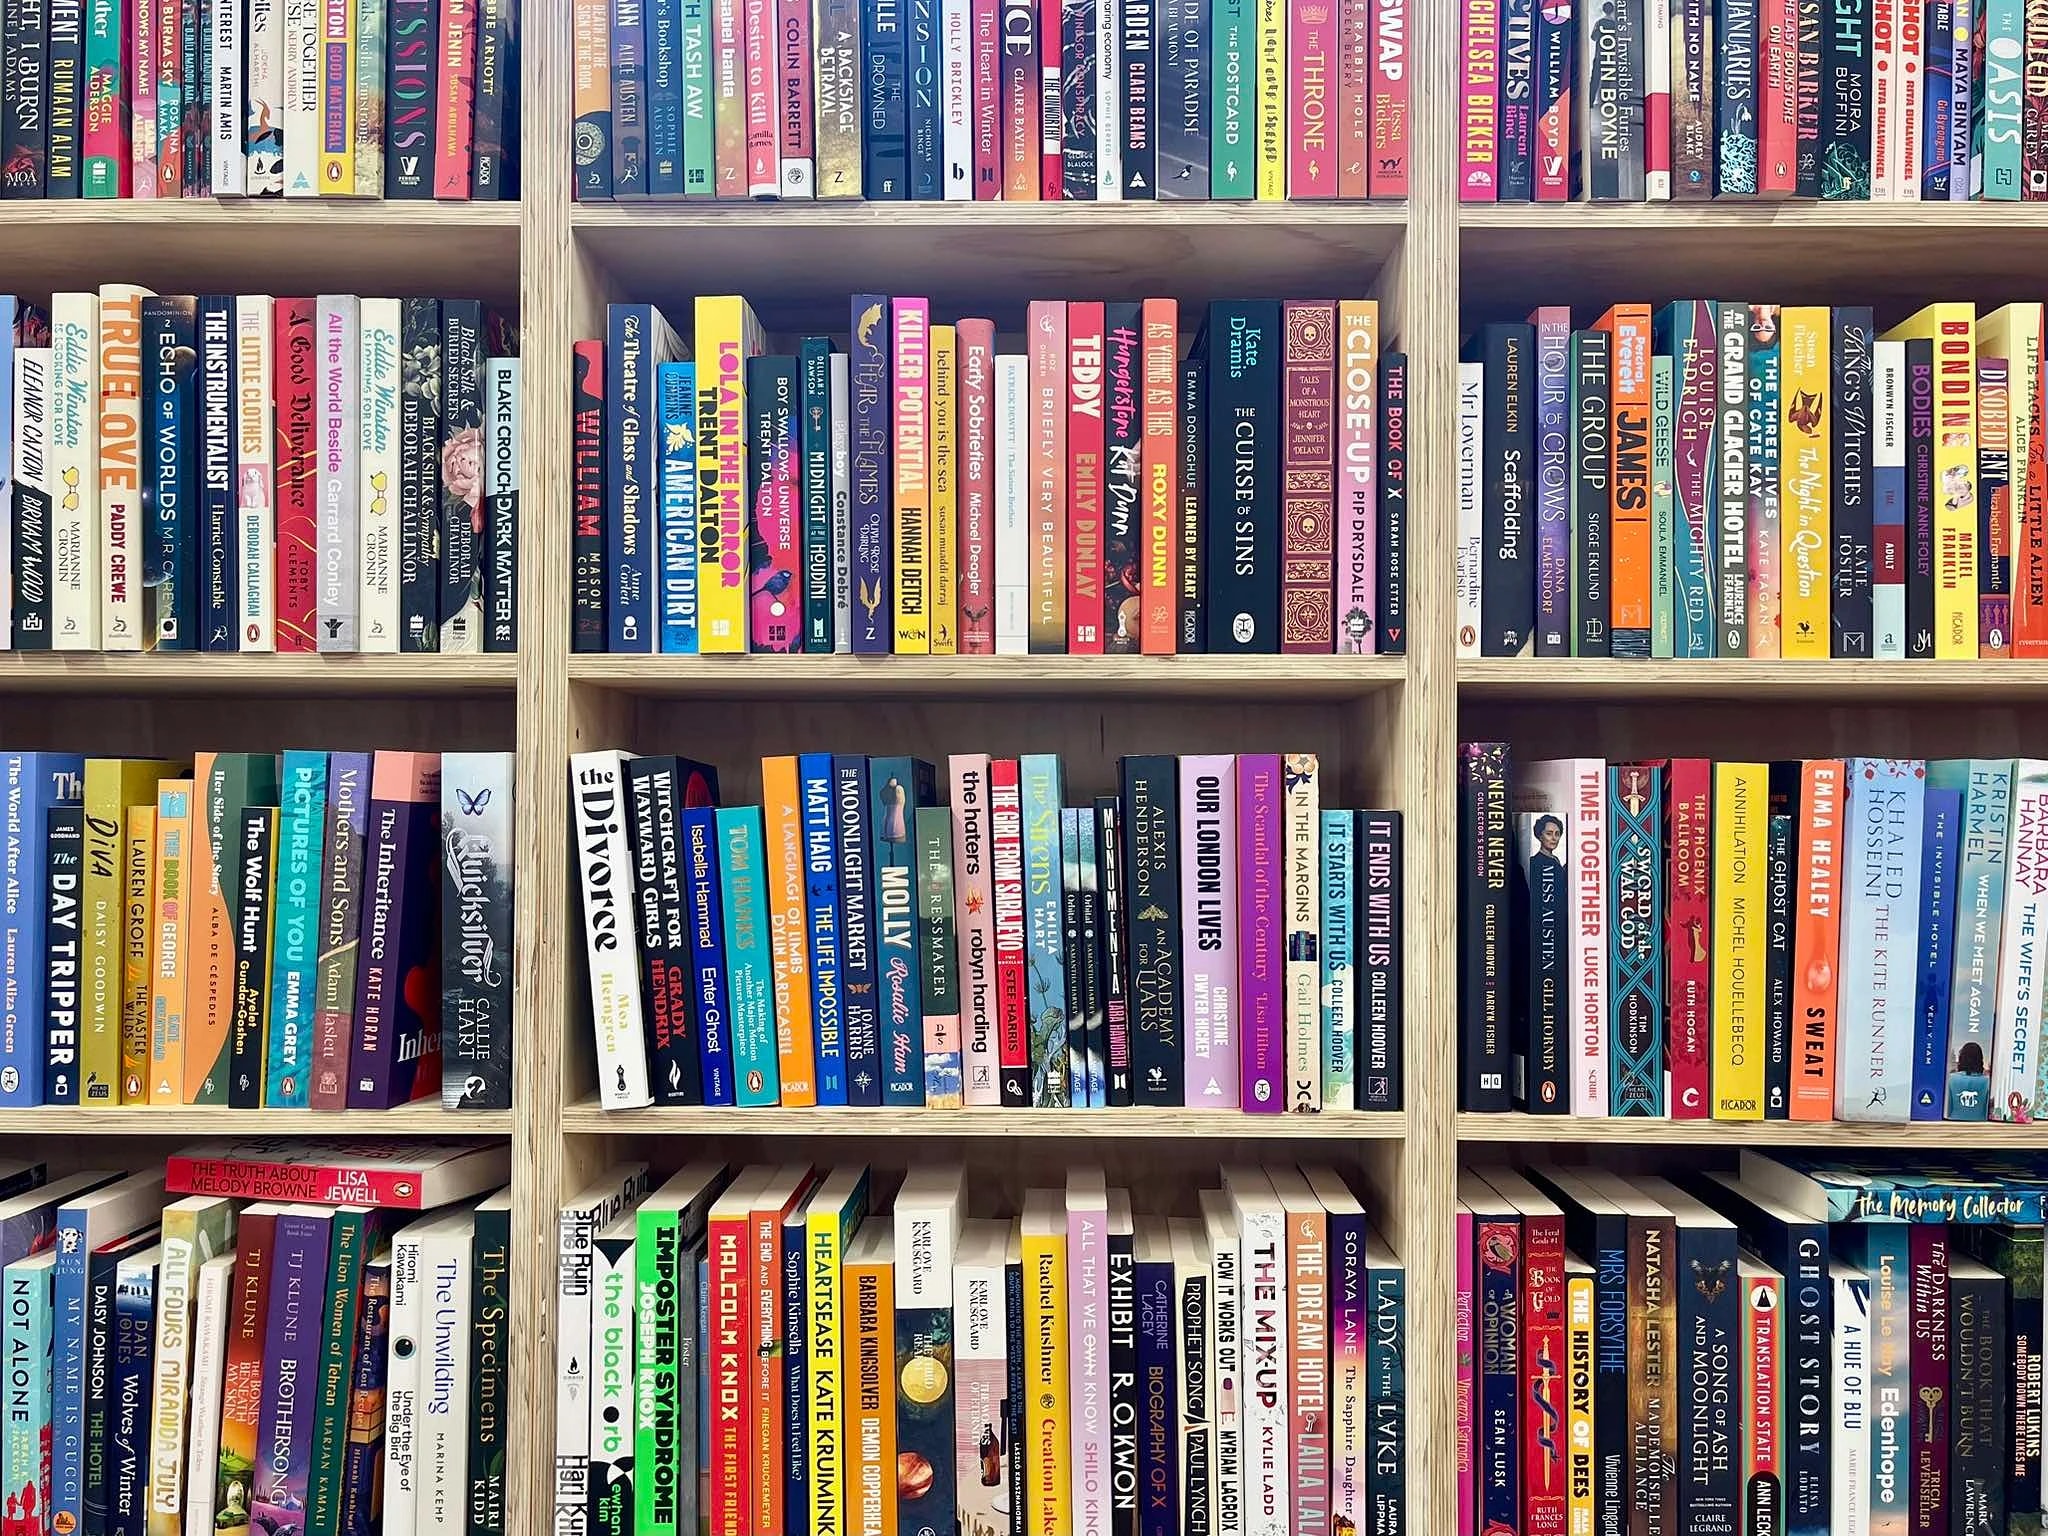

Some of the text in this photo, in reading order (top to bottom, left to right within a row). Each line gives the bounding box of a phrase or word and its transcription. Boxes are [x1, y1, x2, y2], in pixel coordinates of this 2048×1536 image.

[89, 67, 100, 133] ALDERSON
[101, 72, 112, 125] MAGGIE
[219, 66, 232, 141] MARTIN AMIS
[685, 25, 703, 120] TASH AW
[786, 18, 801, 149] COLIN BARRETT
[951, 12, 962, 127] HOLLY BRICKLEY
[1128, 63, 1146, 150] CLARE BEAMS
[1225, 26, 1239, 145] THE POSTCARD
[1304, 32, 1325, 152] THE THRONE
[1549, 31, 1561, 148] WILLIAM BOYD
[1600, 27, 1618, 160] JOHN BOYNE
[1835, 67, 1847, 137] BUFFINI
[1850, 74, 1862, 132] MOIRA
[1953, 48, 1969, 166] MAYA BINYAM
[52, 59, 76, 178] RUMAAN ALAM
[479, 157, 490, 186] PICADOR
[1230, 317, 1246, 379] Dramis
[1245, 329, 1261, 366] Kate
[1300, 376, 1320, 384] TALES
[1302, 387, 1310, 396] OF
[1507, 338, 1518, 433] LAUREN ELKIN
[205, 310, 229, 491] THE INSTRUMENTALIST
[1290, 399, 1330, 407] MONSTROUS
[1293, 434, 1326, 443] JENNIFER
[1298, 410, 1321, 418] HEART
[1885, 367, 1894, 448] BRONWYN FISCHER
[760, 412, 772, 517] TRENT DALTON
[777, 377, 791, 551] BOY SWALLOWS UNIVERSE
[1293, 446, 1325, 454] DELANEY
[1615, 410, 1647, 512] JAMES
[1076, 453, 1098, 600] EMILY DUNLAY
[1499, 449, 1521, 560] Scaffolding
[58, 528, 69, 583] CRONIN
[70, 521, 80, 591] MARIANNE
[109, 504, 127, 604] PADDY CREWE
[211, 504, 224, 610] Harriet Constable
[494, 498, 513, 623] DARK MATTER
[900, 507, 922, 615] HANNAH DEITCH
[1588, 512, 1600, 601] SIGGE EKLUND
[1758, 530, 1769, 625] KATE FAGAN
[1885, 542, 1895, 570] ADULT
[53, 852, 78, 865] The
[807, 779, 832, 873] MATT HAIG
[1135, 779, 1150, 897] HENDERSON
[1151, 806, 1167, 871] ALEXIS
[1196, 775, 1222, 952] OUR LONDON LIVES
[1487, 779, 1504, 889] NEVER NEVER
[242, 816, 265, 954] The Wolf Hunt
[691, 824, 714, 948] Isabella Hammad
[1368, 820, 1391, 967] IT ENDS WITH US
[47, 873, 78, 1065] DAY TRIPPER
[360, 967, 379, 1052] KATE HORAN
[701, 967, 721, 1054] Enter Ghost
[970, 928, 988, 1054] robyn harding
[1685, 979, 1696, 1053] RUTH HOGAN
[457, 998, 474, 1058] HART
[474, 998, 490, 1060] CALLIE
[1370, 970, 1388, 1069] COLLEEN HOOVER
[1628, 994, 1637, 1053] HODKINSON
[1771, 978, 1783, 1064] ALEX HOWARD
[1804, 1006, 1825, 1077] SWEAT
[324, 1185, 381, 1203] JEWELL
[336, 1170, 369, 1187] LISA
[1856, 1195, 2025, 1221] the Memory Collector
[396, 1244, 407, 1306] Kawakami
[407, 1244, 417, 1284] Hiromi
[1110, 1255, 1133, 1349] EXHIBIT
[1344, 1231, 1357, 1356] SORAYA LANE
[10, 1280, 31, 1423] NOT ALONE
[90, 1286, 107, 1400] DAISY JOHNSON
[639, 1281, 657, 1431] JOSEPH KNOX
[815, 1232, 834, 1422] HEARTSEASE KATE
[1217, 1252, 1236, 1373] HOW IT WORKS OUT
[1756, 1318, 1771, 1462] TRANSLATION STATE
[1843, 1325, 1861, 1430] A HUE OF BLU
[2025, 1354, 2042, 1458] ROBERT LUKINS
[388, 1390, 402, 1461] the Big Bird
[399, 1390, 414, 1492] Under the Eye of
[1494, 1410, 1505, 1487] SEAN LUSK
[472, 1479, 485, 1524] KIDD
[486, 1475, 500, 1529] MAIRI
[1690, 1524, 1732, 1532] LEGRAND
[1695, 1514, 1726, 1522] CLAIRE
